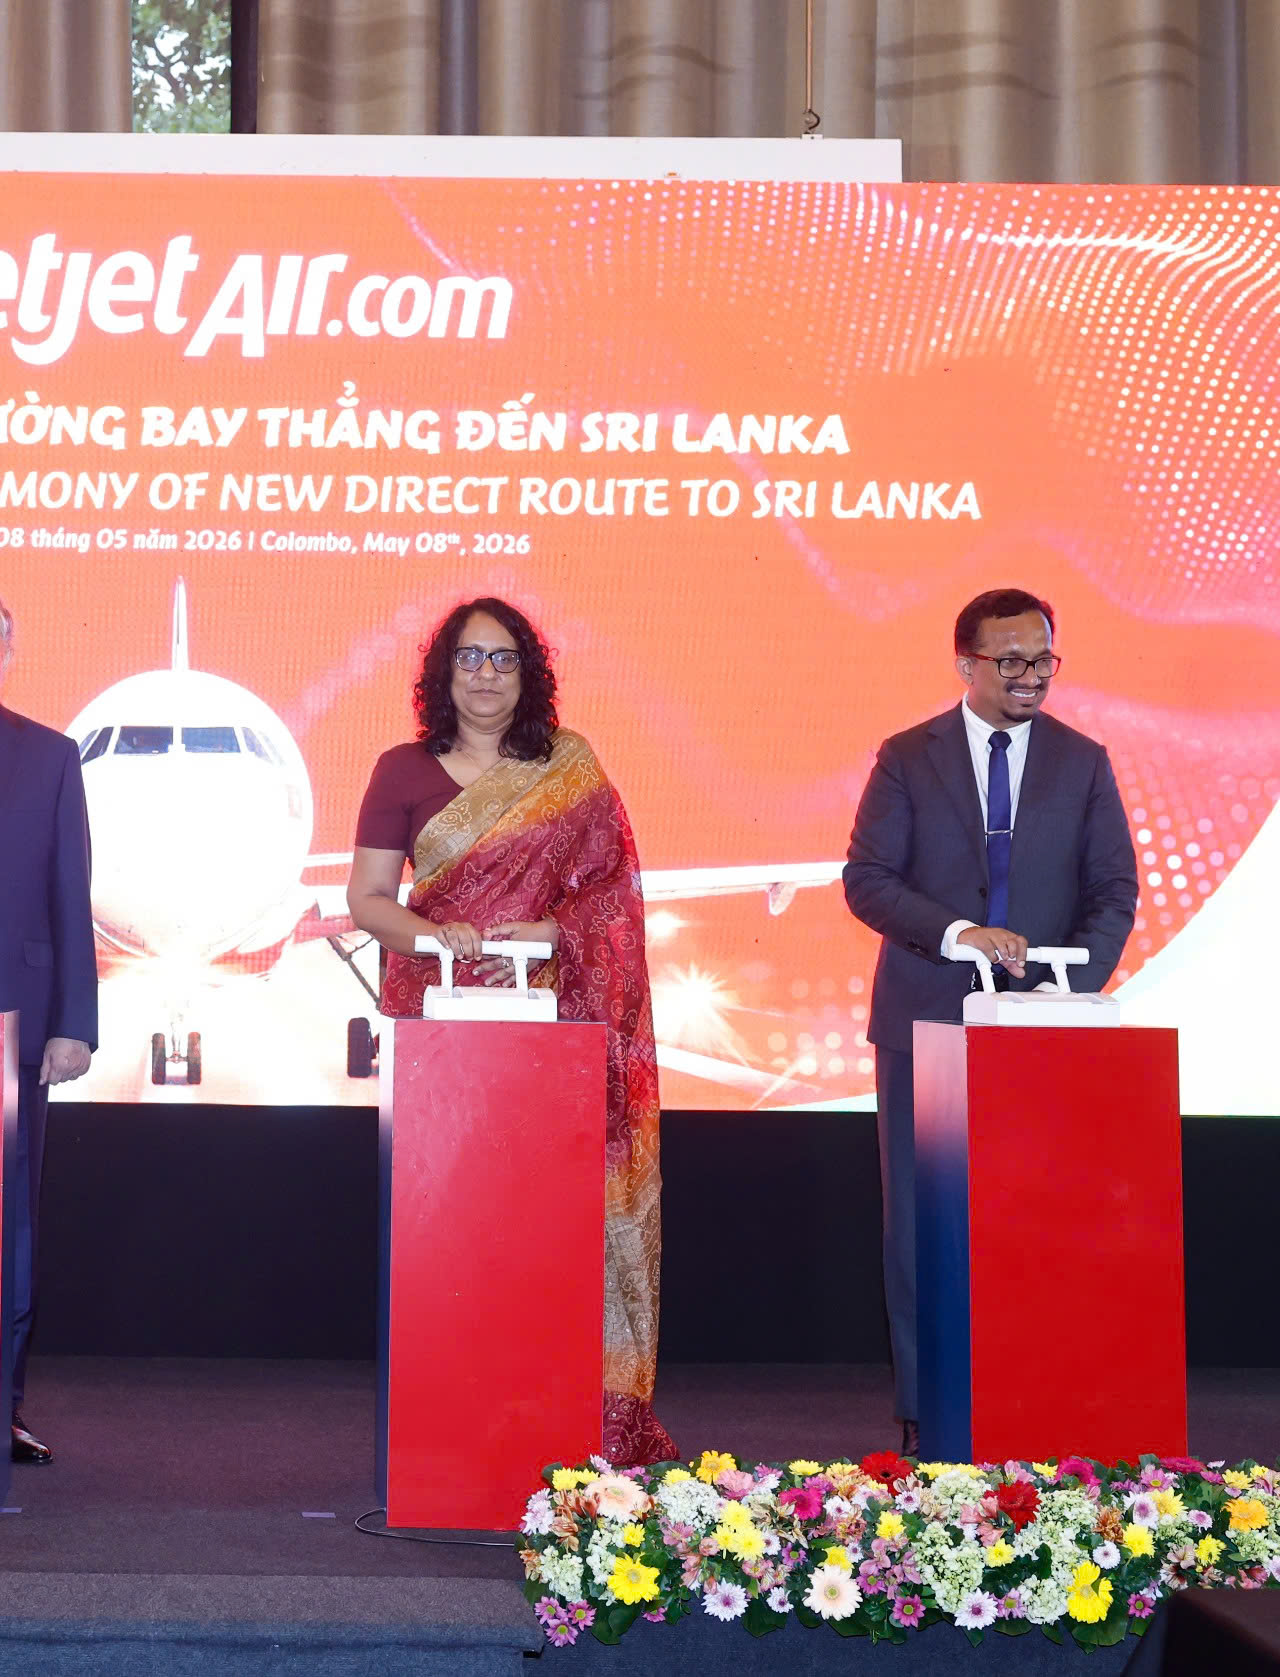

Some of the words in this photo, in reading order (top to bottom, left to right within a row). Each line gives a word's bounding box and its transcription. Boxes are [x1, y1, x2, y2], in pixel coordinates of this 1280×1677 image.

[139, 405, 249, 448] BAY
[256, 380, 441, 455] THẲNG
[454, 392, 568, 452] ĐẾN
[579, 411, 660, 453] SRI
[671, 412, 851, 456] LANKA
[148, 471, 210, 511] OF
[219, 472, 334, 513] NEW
[343, 474, 509, 515] DIRECT
[519, 476, 669, 517] ROUTE
[680, 478, 741, 517] TO
[751, 479, 817, 519] SRI
[831, 480, 982, 521] LANKA
[29, 525, 92, 554] tháng
[95, 527, 129, 551] 05
[132, 527, 179, 550] năm
[183, 528, 243, 552] 2026
[259, 529, 359, 555] Colombo,
[362, 531, 411, 558] May
[471, 532, 531, 555] 2026
